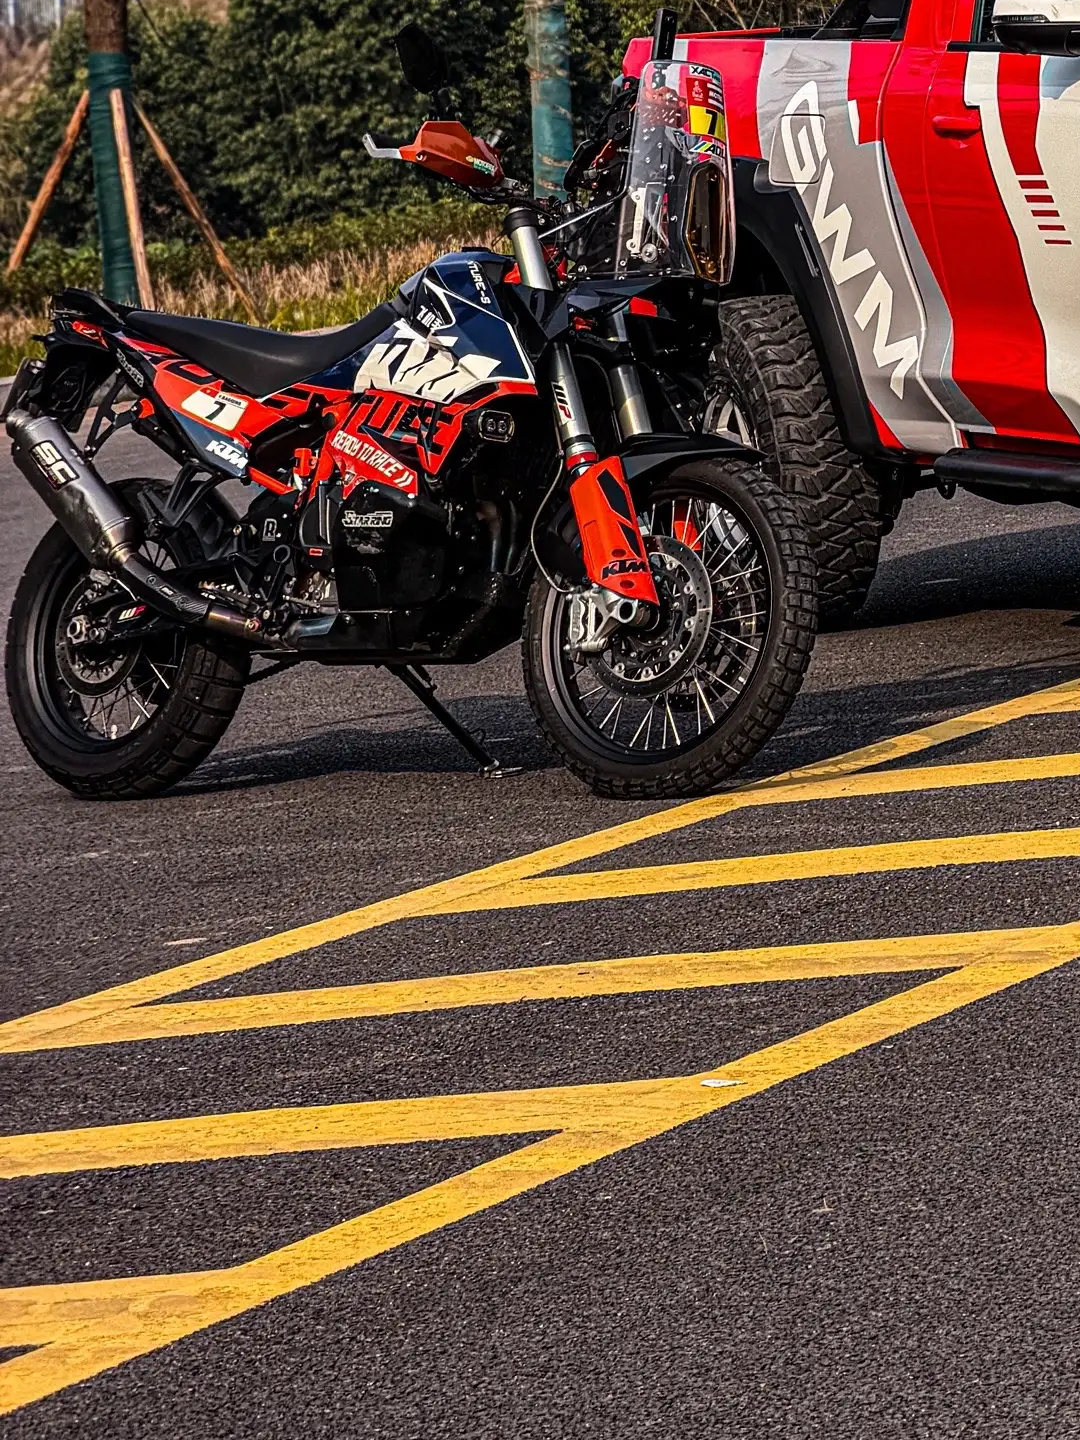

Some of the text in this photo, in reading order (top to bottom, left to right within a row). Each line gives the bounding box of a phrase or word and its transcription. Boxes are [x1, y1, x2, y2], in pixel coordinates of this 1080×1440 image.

[705, 109, 718, 136] 7
[780, 80, 919, 400] GWM
[354, 318, 502, 406] KTM
[205, 400, 226, 421] 7
[35, 441, 77, 485] SC
[206, 440, 249, 470] KTM
[330, 430, 402, 478] READY TO RACE
[602, 559, 647, 581] KTM
